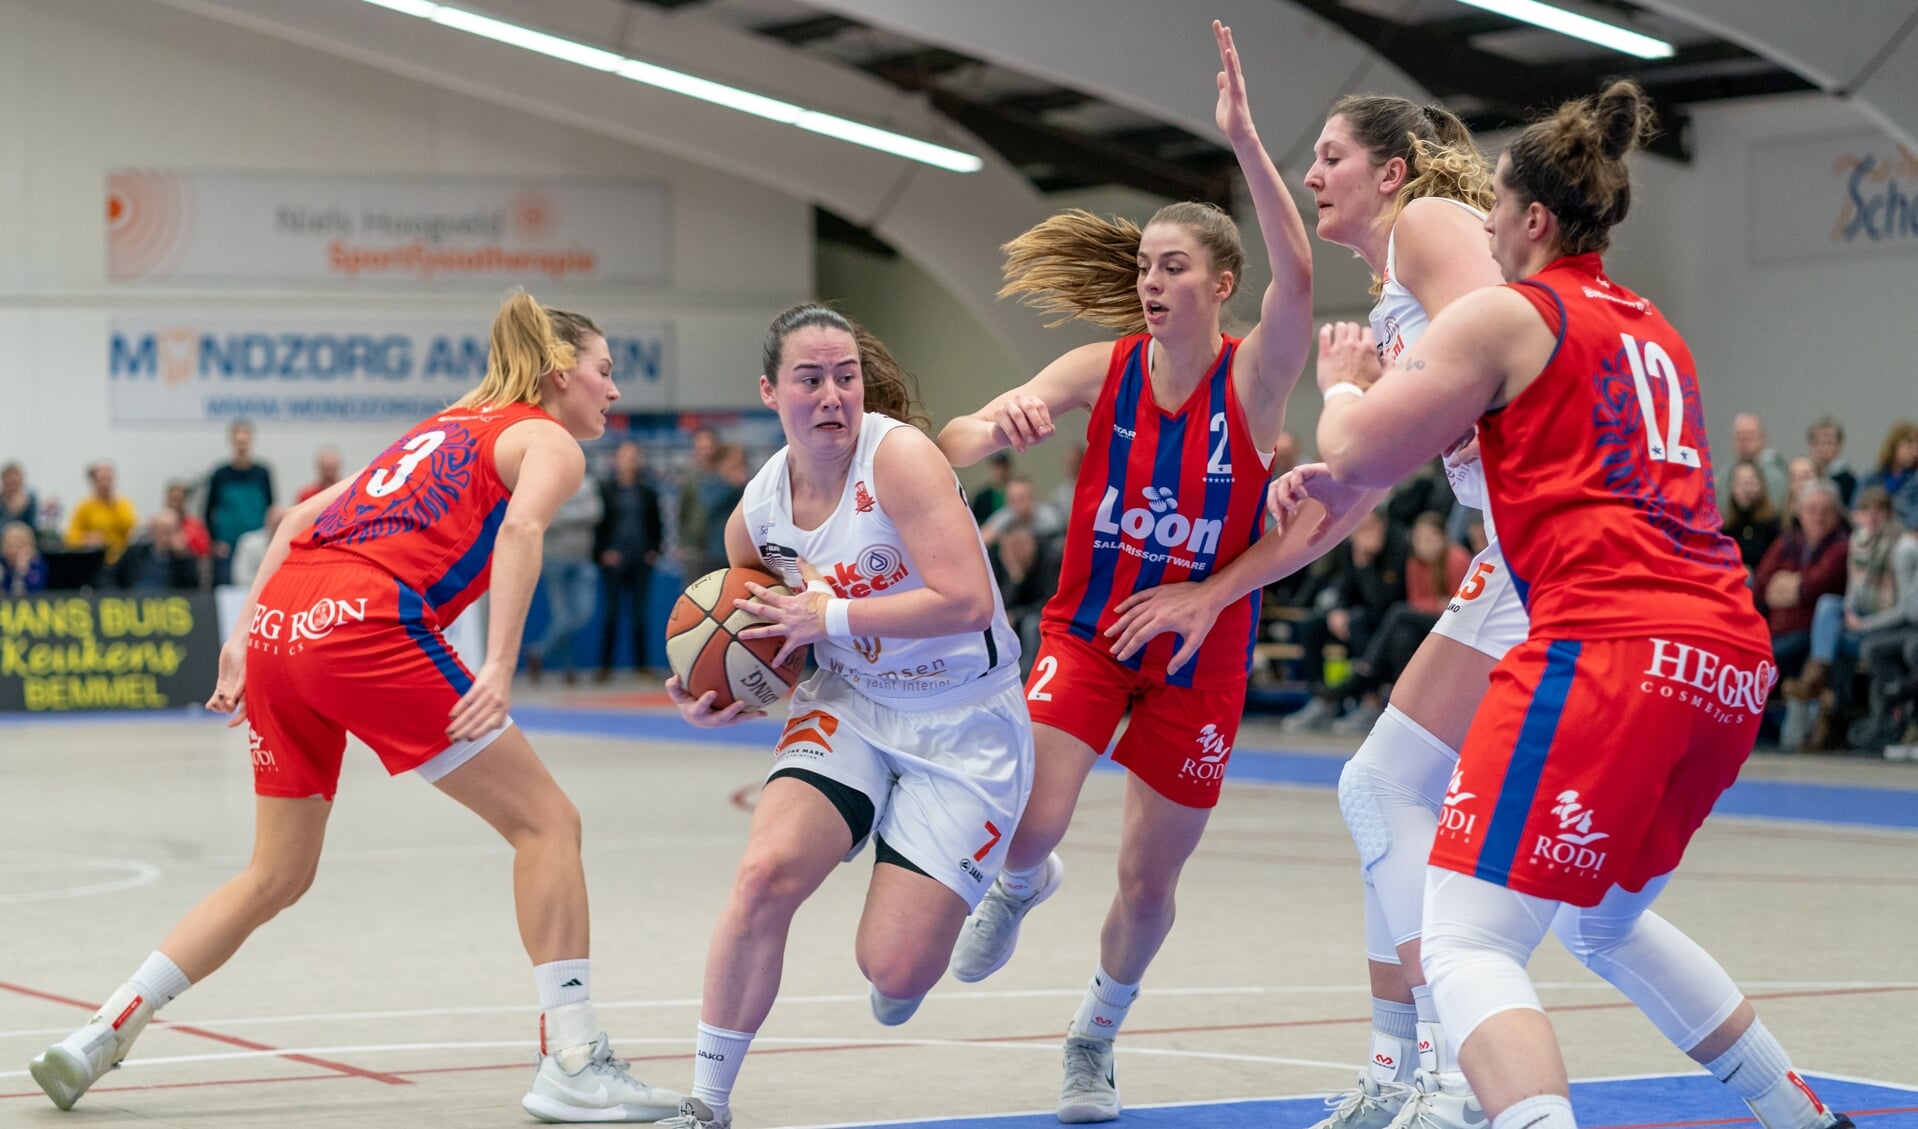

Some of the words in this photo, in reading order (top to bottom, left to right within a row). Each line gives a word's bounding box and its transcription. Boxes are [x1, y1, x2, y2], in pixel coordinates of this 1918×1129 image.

[1620, 332, 1701, 468] 12
[366, 430, 446, 498] 3
[1207, 412, 1232, 474] 2
[1093, 485, 1223, 555] Loon
[1093, 540, 1206, 570] SALARISSOFTWARE
[100, 597, 193, 637] BUIS
[250, 598, 368, 643] EGRON
[25, 674, 168, 710] BEMMEL
[1027, 656, 1058, 702] 2
[1640, 681, 1745, 724] COSMETICS
[973, 820, 1002, 862] 7
[1532, 834, 1607, 872] RODI
[697, 1049, 725, 1061] JAKO
